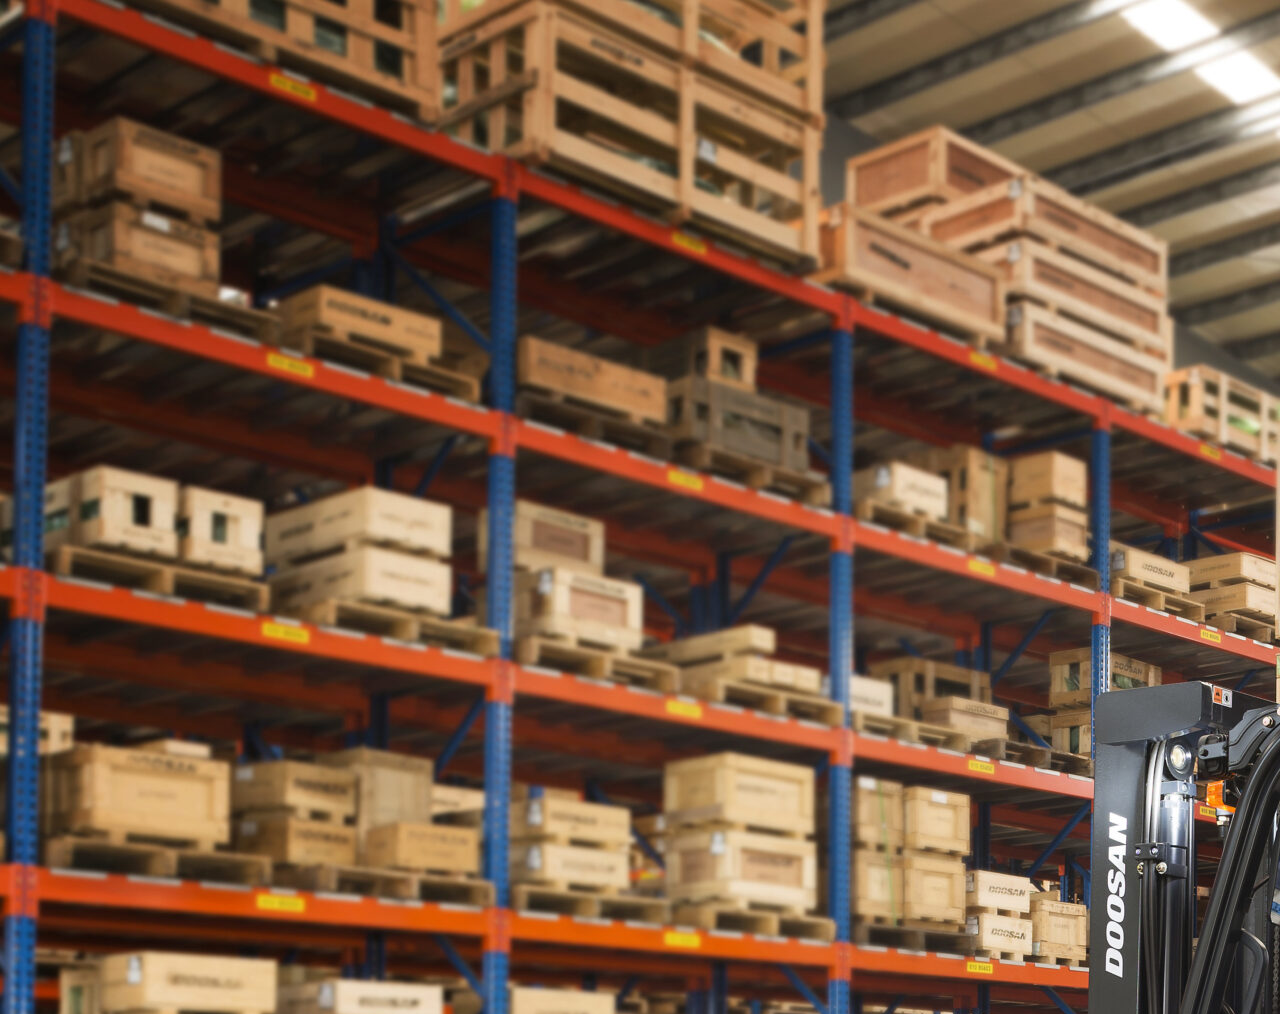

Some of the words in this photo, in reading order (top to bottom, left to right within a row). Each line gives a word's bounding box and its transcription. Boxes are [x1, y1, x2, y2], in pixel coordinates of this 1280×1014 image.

[1142, 563, 1175, 579] DOOSAN
[1113, 660, 1143, 677] DOOSAN
[989, 885, 1026, 897] DOOSAN
[1105, 812, 1128, 978] DOOSAN
[991, 928, 1026, 940] DOOSAN
